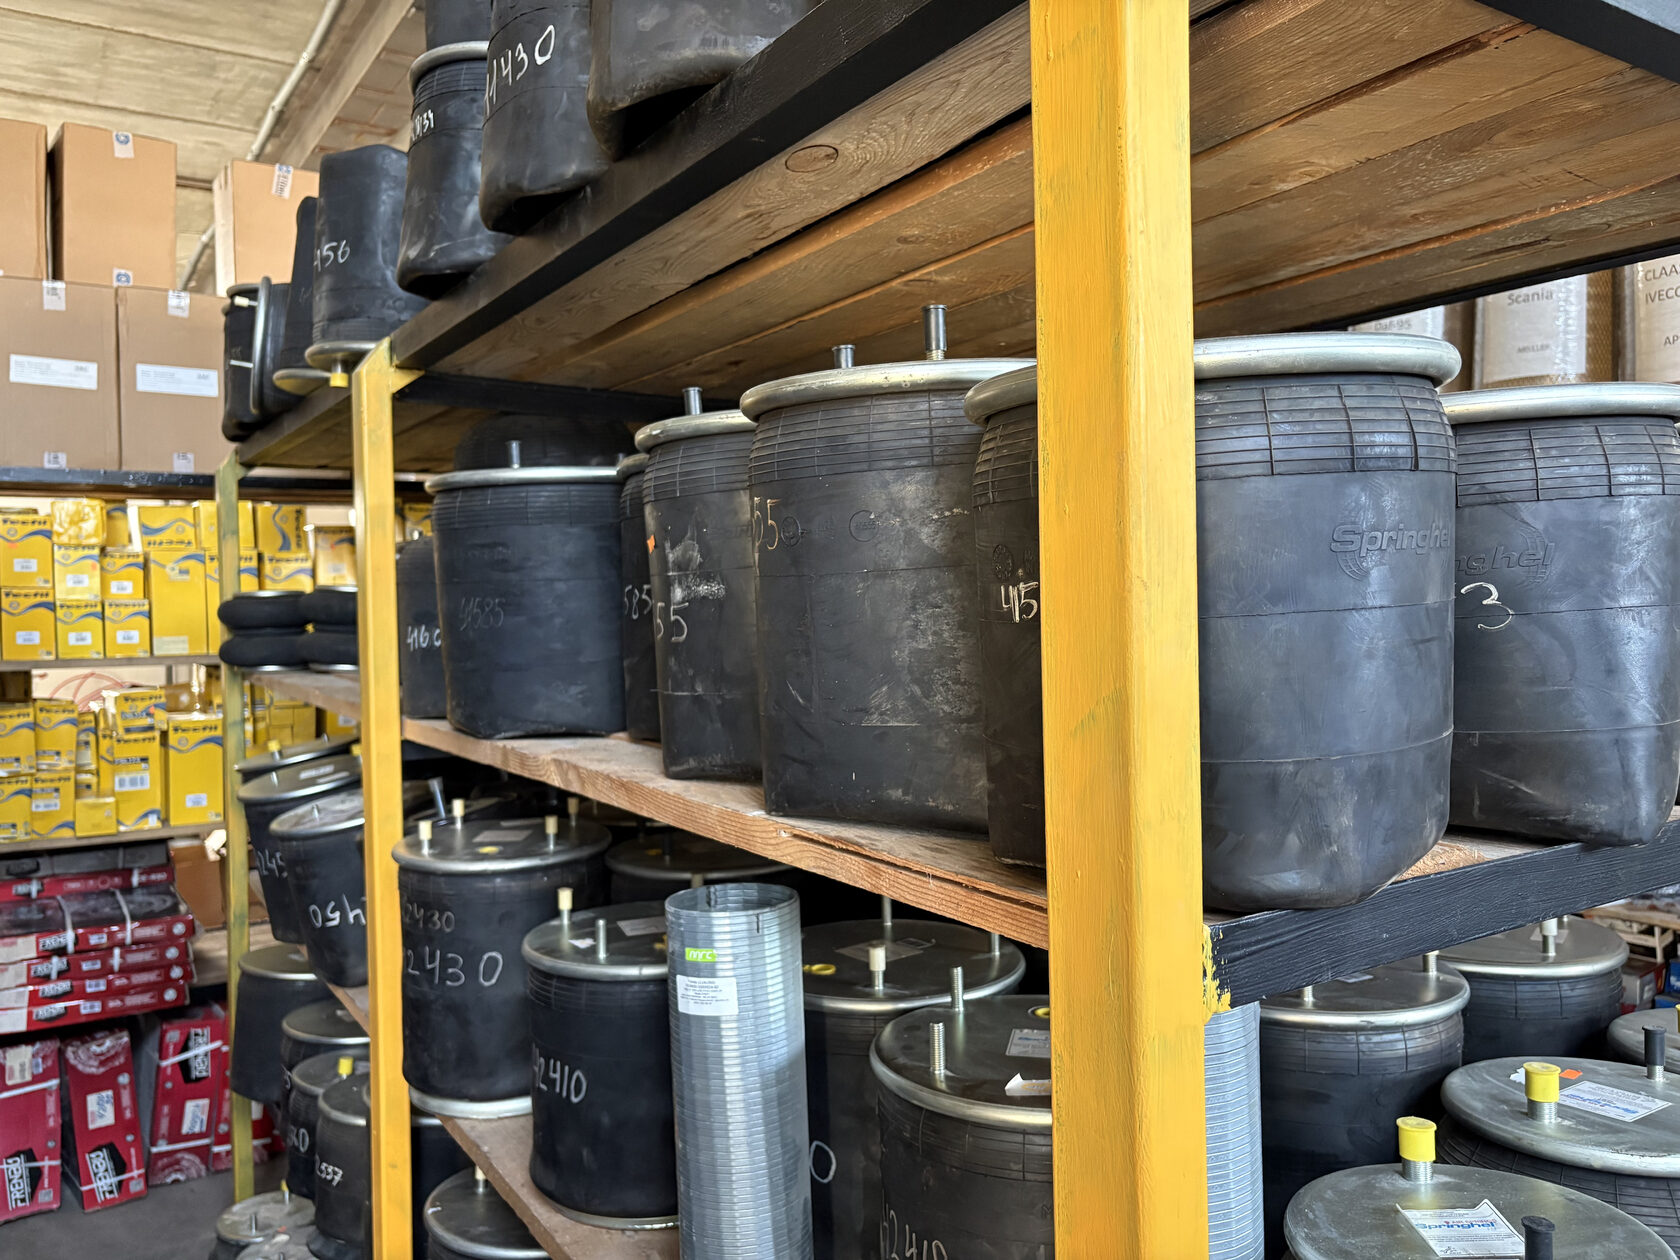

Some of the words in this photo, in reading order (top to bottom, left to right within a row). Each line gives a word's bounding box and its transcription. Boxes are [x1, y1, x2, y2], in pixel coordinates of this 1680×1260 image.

[1644, 264, 1680, 282] CLAA
[1507, 288, 1554, 306] Scania
[1330, 523, 1451, 557] Springhe
